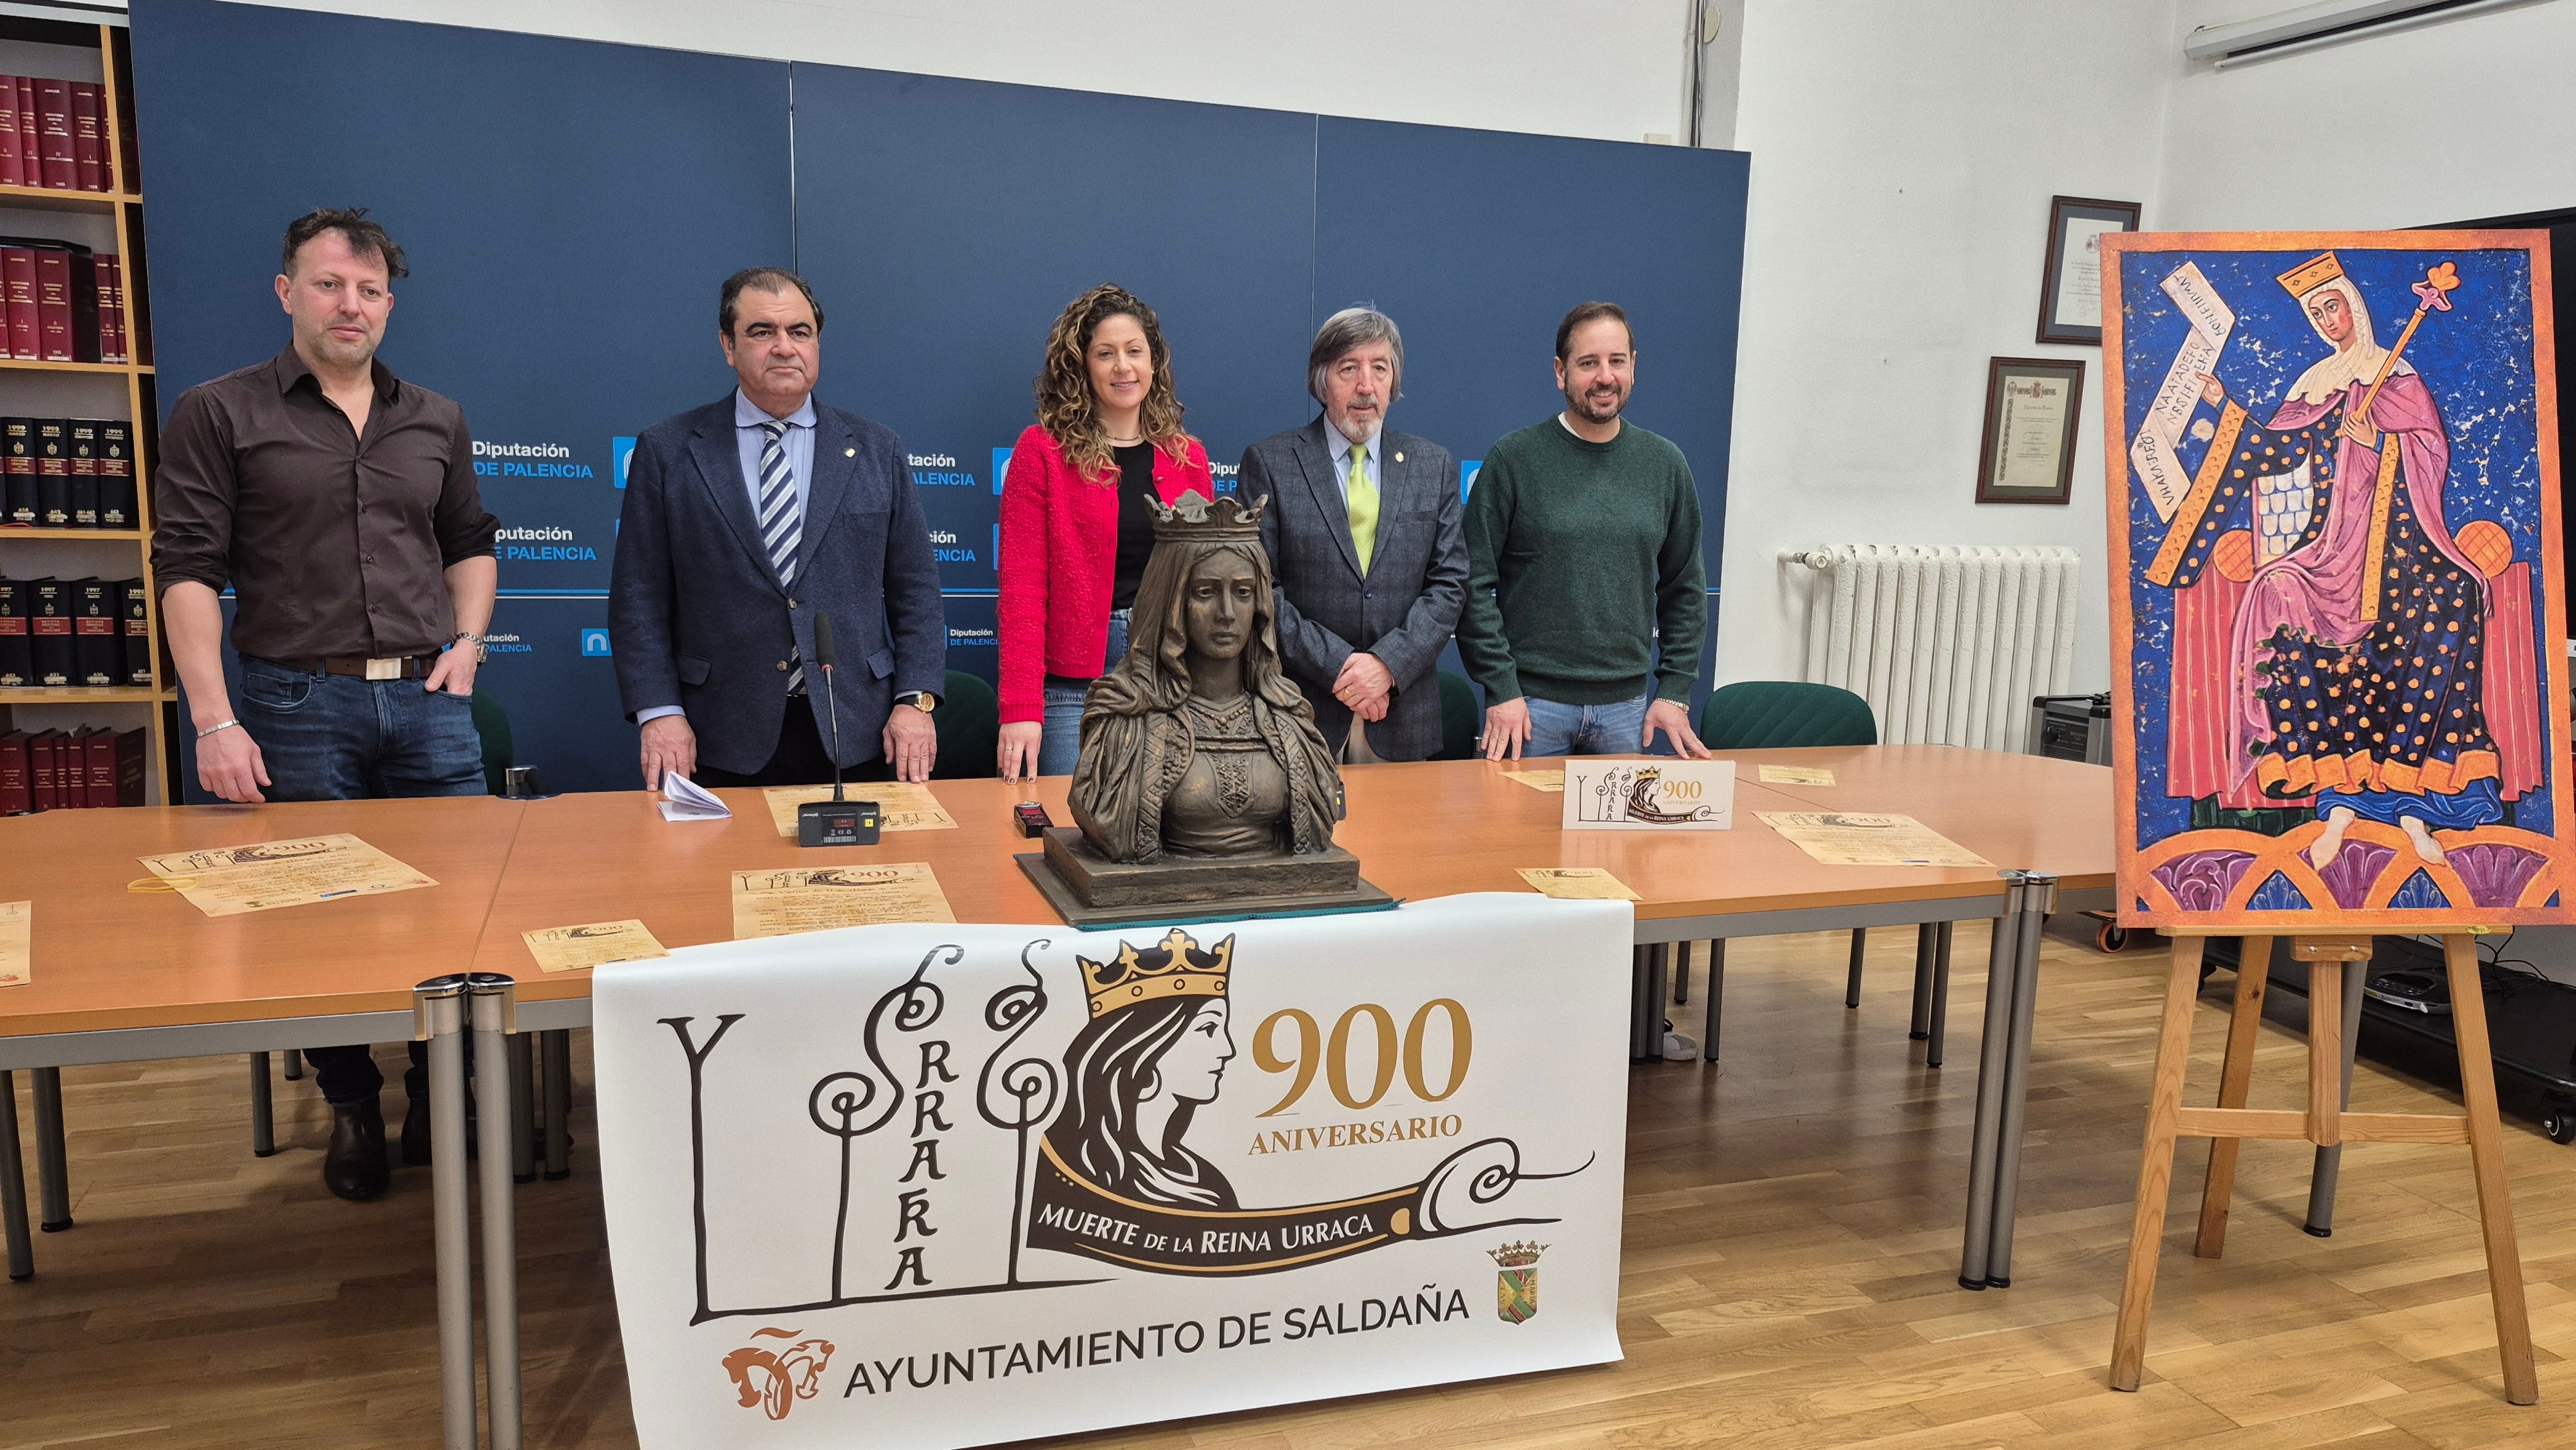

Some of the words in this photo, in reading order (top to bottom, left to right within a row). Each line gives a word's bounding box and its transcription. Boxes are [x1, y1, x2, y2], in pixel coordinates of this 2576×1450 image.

[472, 441, 569, 458] Diputación
[907, 454, 956, 467] tación
[473, 462, 498, 476] DE
[504, 463, 594, 478] PALENCIA
[495, 527, 573, 543] putación
[507, 547, 596, 560] PALENCIA
[934, 549, 976, 562] ENCIA
[484, 634, 520, 643] utación
[950, 628, 994, 638] Diputación
[1663, 780, 1702, 799] 900
[1629, 809, 1645, 817] MUERTE
[849, 870, 900, 878] 900
[1252, 998, 1473, 1118] 900
[1247, 1114, 1463, 1155] ANIVERSARIO
[1037, 1203, 1141, 1246] MUERTE
[1200, 1230, 1271, 1254] REINA
[1281, 1214, 1374, 1250] URRACA
[843, 1321, 1206, 1398] AYUNTAMIENTO
[1219, 1311, 1271, 1348] DE
[1283, 1282, 1470, 1340] SALDAÑA
